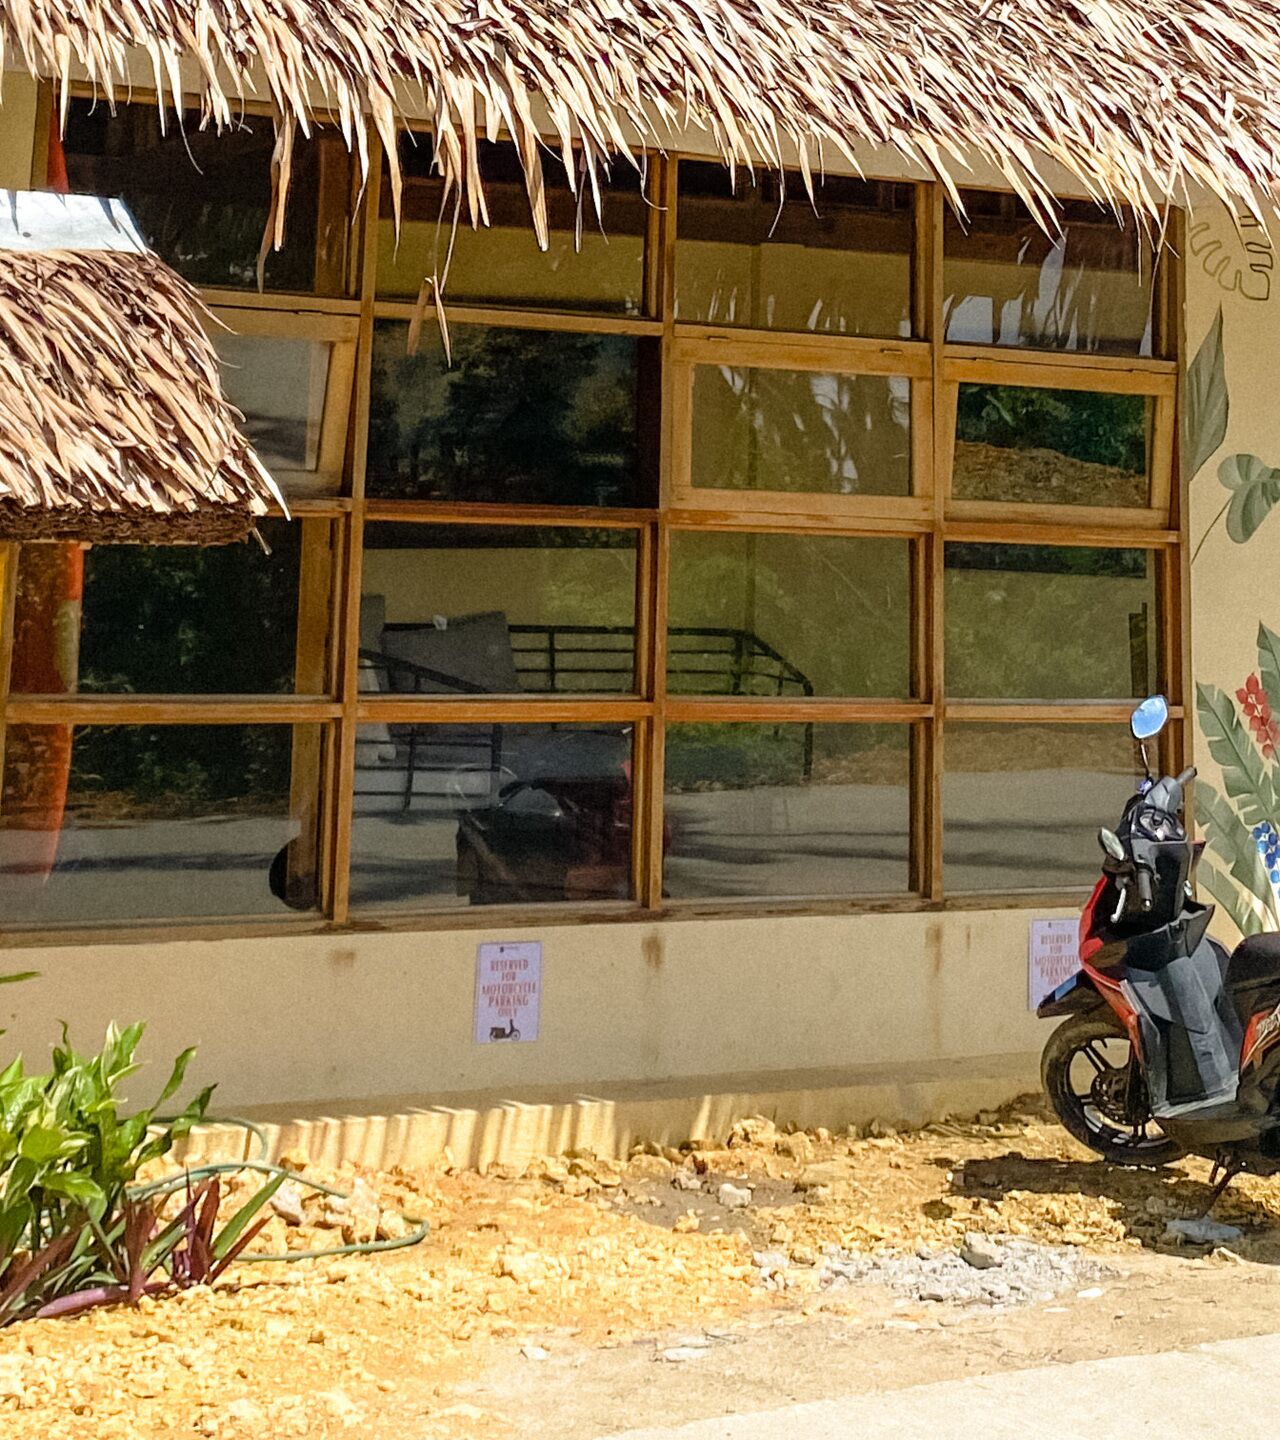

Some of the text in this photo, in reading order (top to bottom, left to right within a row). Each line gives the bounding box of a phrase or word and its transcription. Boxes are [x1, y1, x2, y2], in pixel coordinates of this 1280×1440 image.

[490, 959, 529, 971] RESERVED
[502, 972, 517, 981] FOR
[482, 982, 537, 995] MOTORCYCLE
[488, 994, 529, 1007] PARKING
